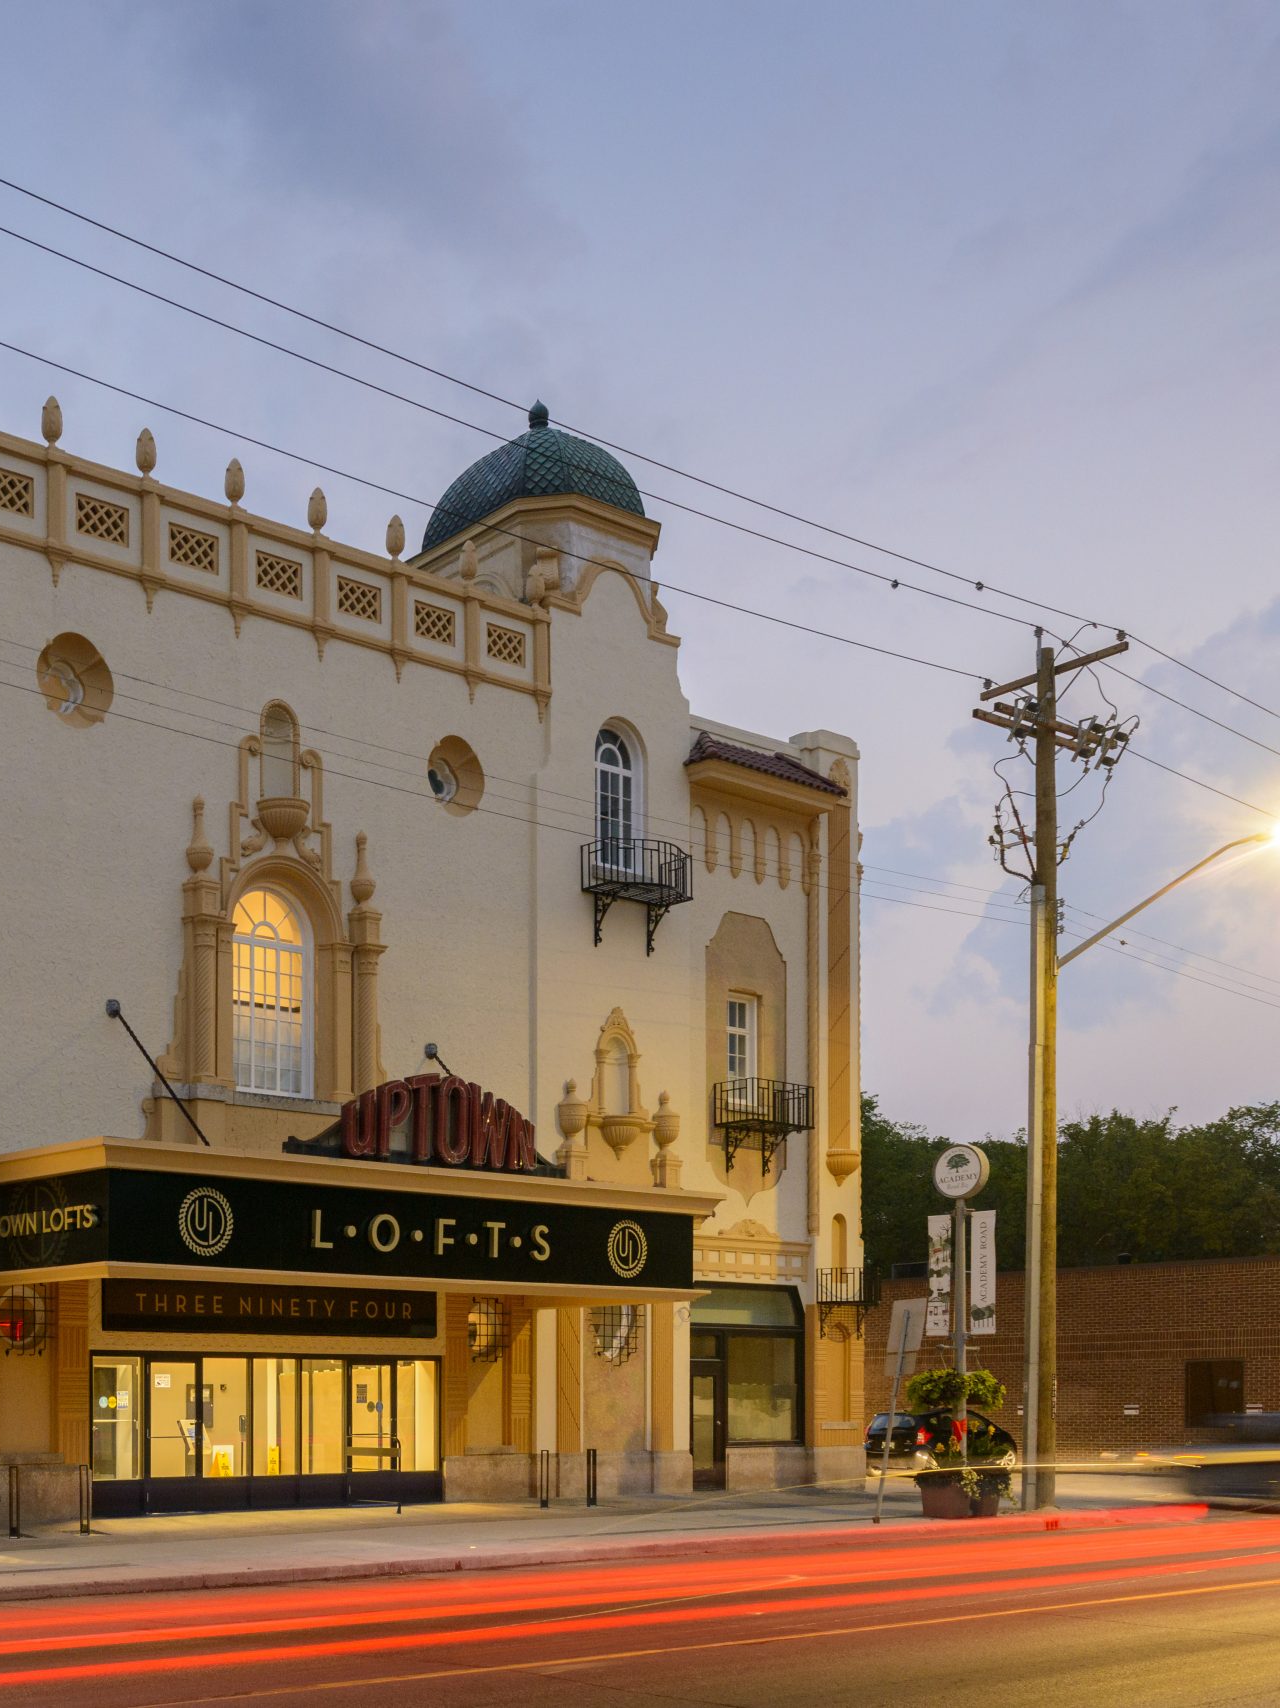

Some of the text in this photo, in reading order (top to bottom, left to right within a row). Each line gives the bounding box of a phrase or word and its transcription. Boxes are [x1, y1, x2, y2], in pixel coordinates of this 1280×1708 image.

[341, 1072, 537, 1170] UPTOWN
[938, 1173, 978, 1184] ACADEMY
[42, 1203, 98, 1233] LOFTS
[979, 1221, 988, 1303] ACADEMY ROAD
[135, 1293, 413, 1320] THREE NINETY FOUR
